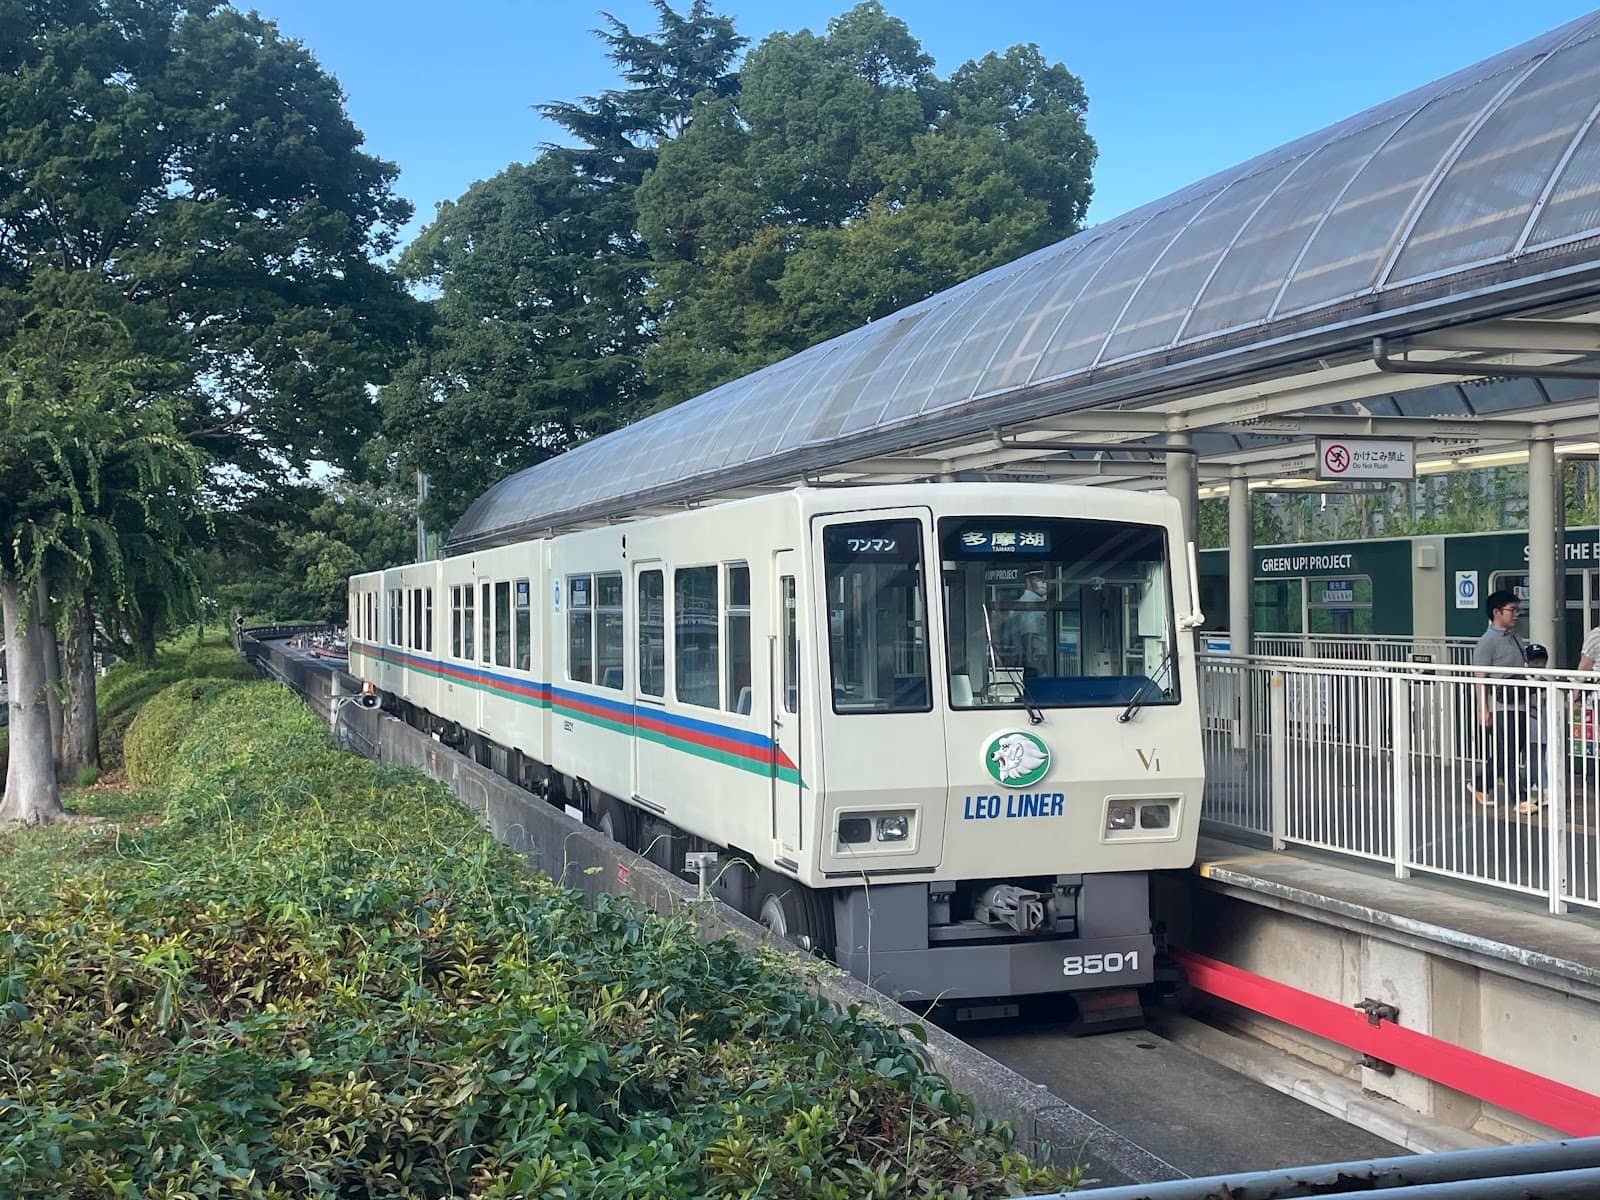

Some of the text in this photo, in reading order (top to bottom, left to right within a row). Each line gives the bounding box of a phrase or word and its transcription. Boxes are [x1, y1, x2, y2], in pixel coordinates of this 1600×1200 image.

[1353, 450, 1406, 462] かけこみ禁止
[847, 538, 896, 552] ワンマン
[962, 532, 1044, 546] 多摩湖
[1565, 543, 1589, 560] THE
[1261, 554, 1353, 572] GREEN UP! PROJECT
[964, 792, 1065, 820] LEO LINER
[1063, 951, 1139, 976] 8501
